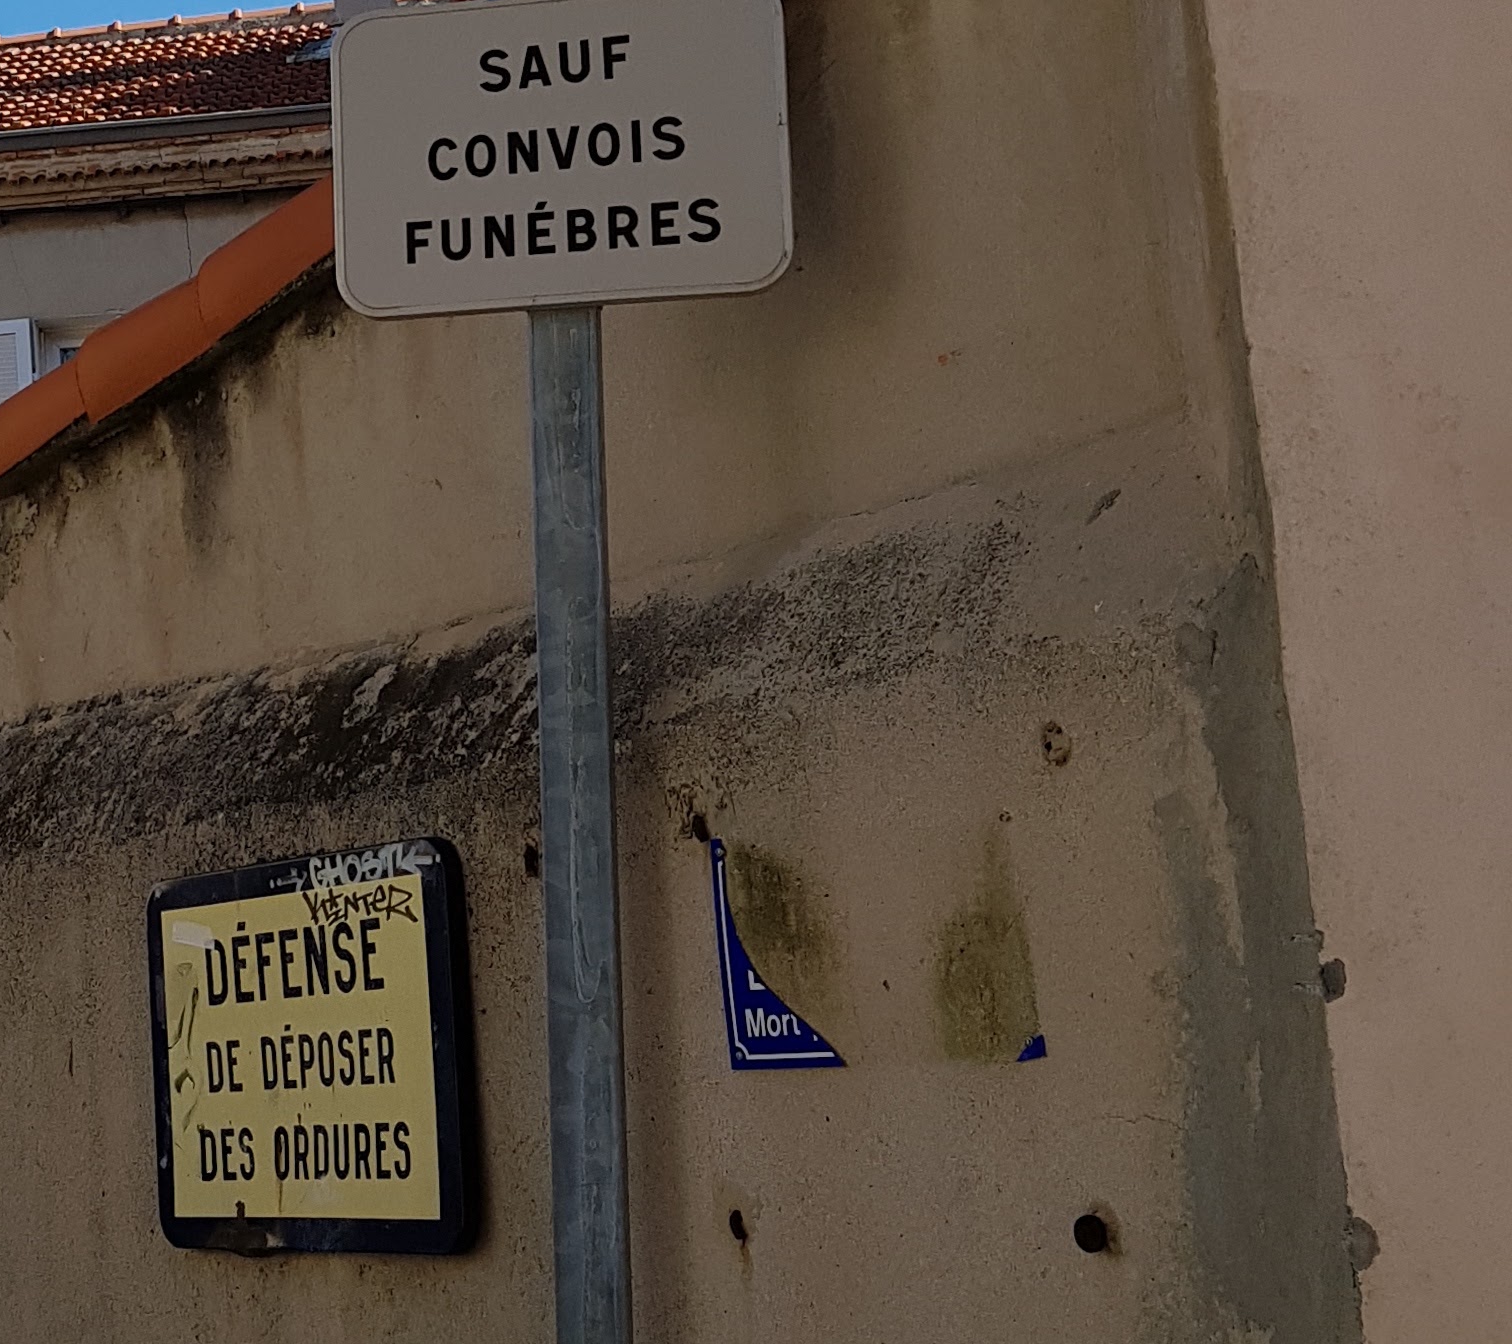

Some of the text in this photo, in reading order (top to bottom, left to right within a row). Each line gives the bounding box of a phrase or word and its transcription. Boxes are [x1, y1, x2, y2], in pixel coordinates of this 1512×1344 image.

[479, 34, 630, 93] SAUF
[427, 116, 686, 181] CONVOIS
[405, 198, 722, 265] FUNÉBRES
[204, 917, 385, 1007] DÉFENSE
[205, 1023, 396, 1094] DE DÉPOSER
[199, 1120, 412, 1182] DES ORDURES
